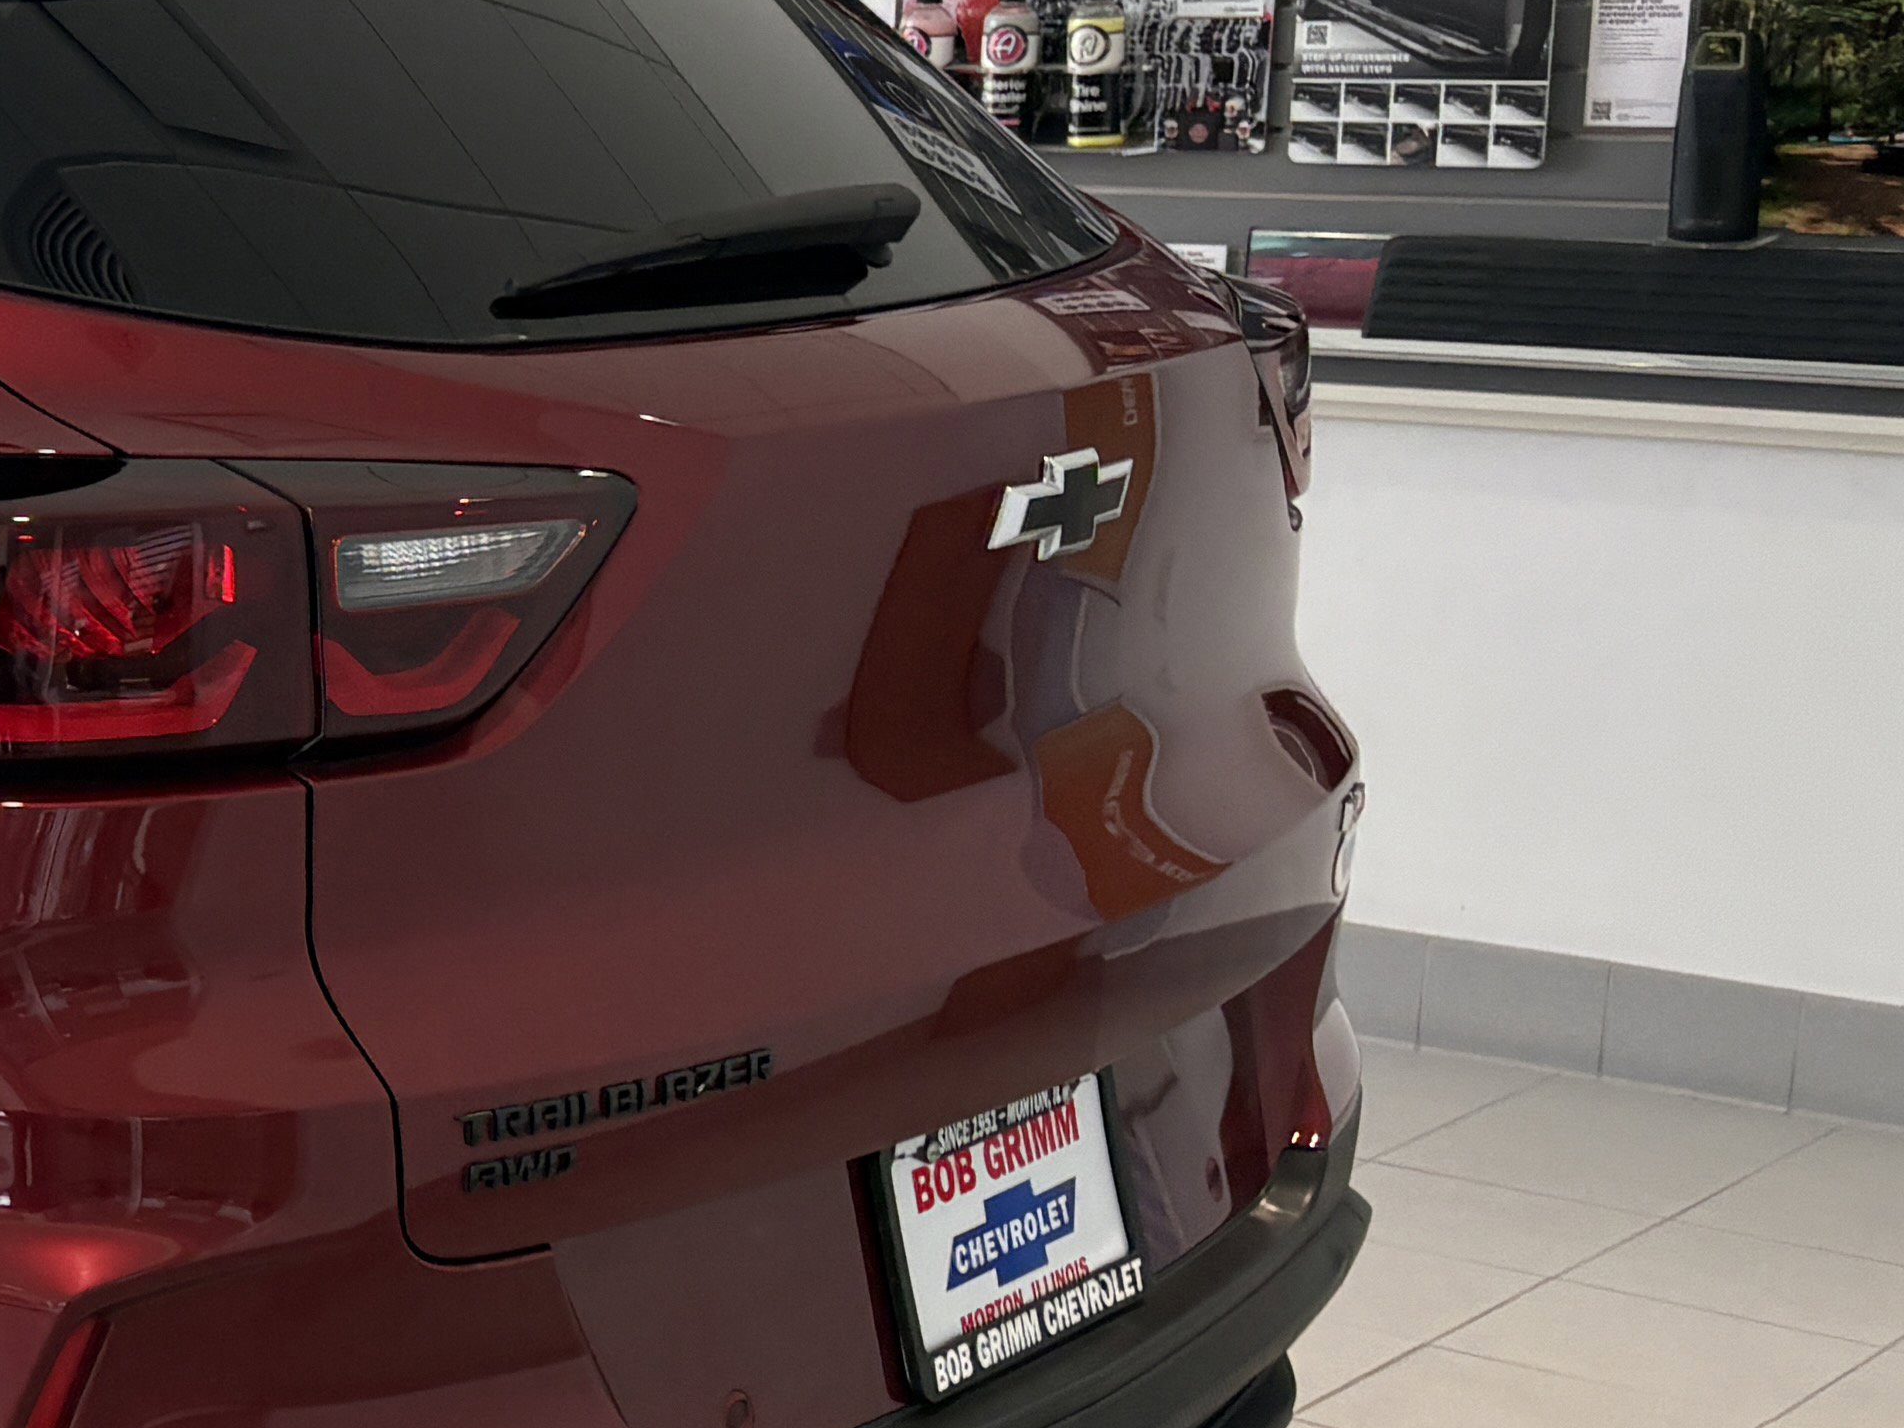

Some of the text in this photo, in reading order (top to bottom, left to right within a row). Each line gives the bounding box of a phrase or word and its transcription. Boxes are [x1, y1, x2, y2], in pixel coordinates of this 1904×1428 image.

[454, 1047, 774, 1146] TRAILBLAZER
[464, 1144, 577, 1192] AWD
[911, 1099, 1080, 1214] BOB GRIMM
[938, 1119, 970, 1154] SINCE
[954, 1195, 1070, 1274] CHEVROLET
[934, 1258, 1143, 1392] BOB GRIMM CHEVROLET
[961, 1257, 1090, 1335] MORTON ILLINOIS
